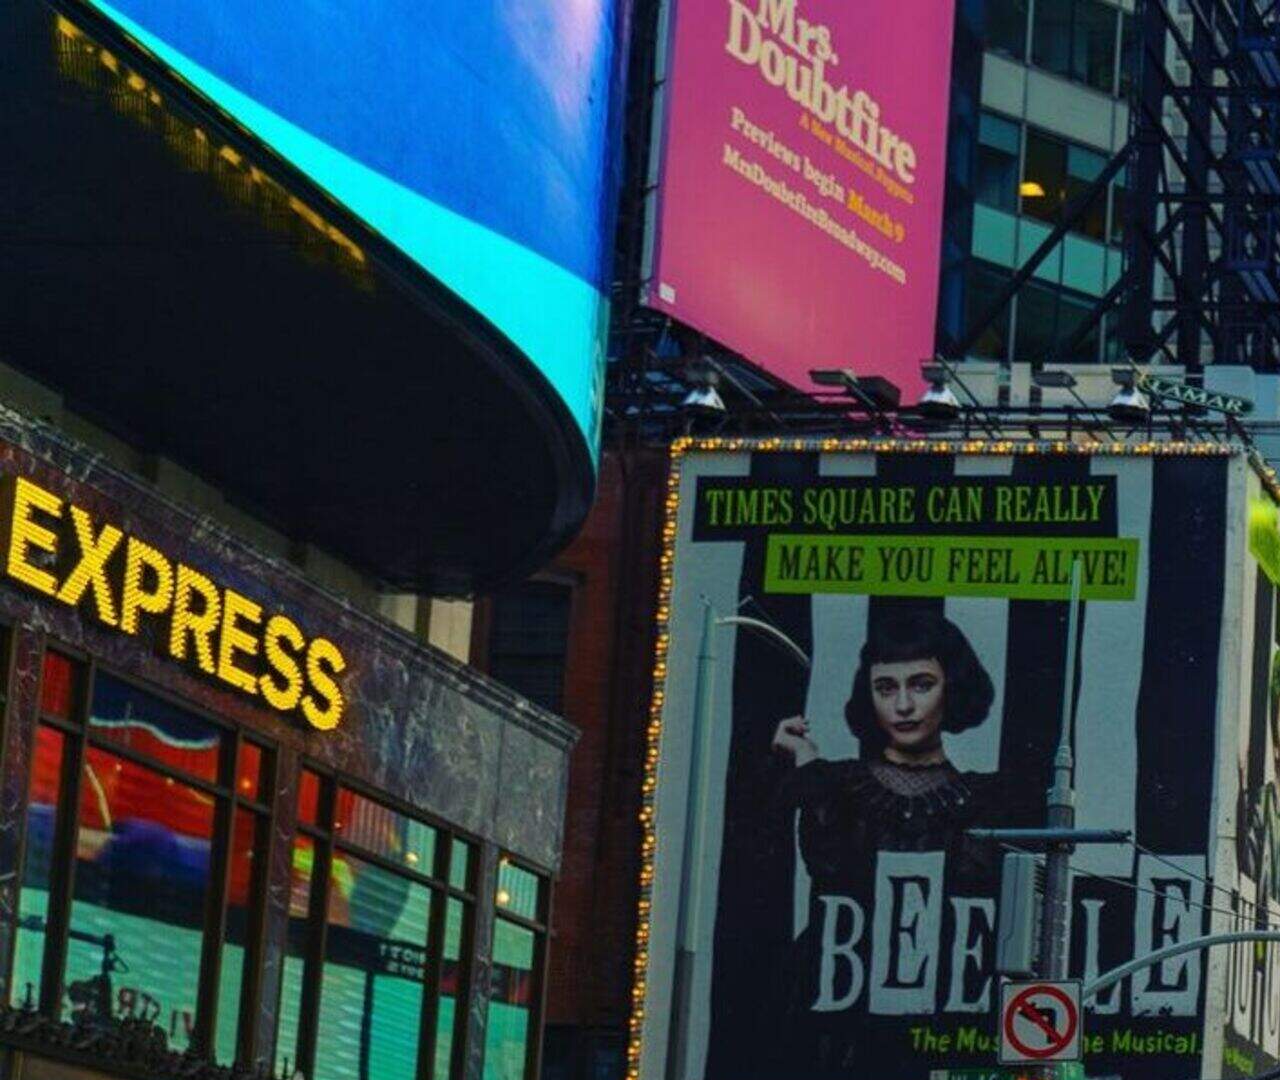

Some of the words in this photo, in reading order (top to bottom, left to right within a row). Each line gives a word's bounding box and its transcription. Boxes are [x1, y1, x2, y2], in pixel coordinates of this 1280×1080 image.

[758, 0, 838, 65] Mrs.
[725, 0, 917, 184] Doubtfire
[731, 106, 801, 173] Previews
[803, 156, 845, 203] begin
[706, 488, 794, 526] TIMES
[802, 488, 916, 531] SQUARE
[927, 487, 984, 522] CAN
[998, 485, 1106, 523] REALLY
[7, 476, 345, 731] EXPRESS
[779, 546, 864, 582] MAKE
[879, 547, 935, 583] YOU
[947, 549, 1020, 585] FEEL
[809, 858, 1206, 1015] BEELE
[911, 1028, 952, 1051] The
